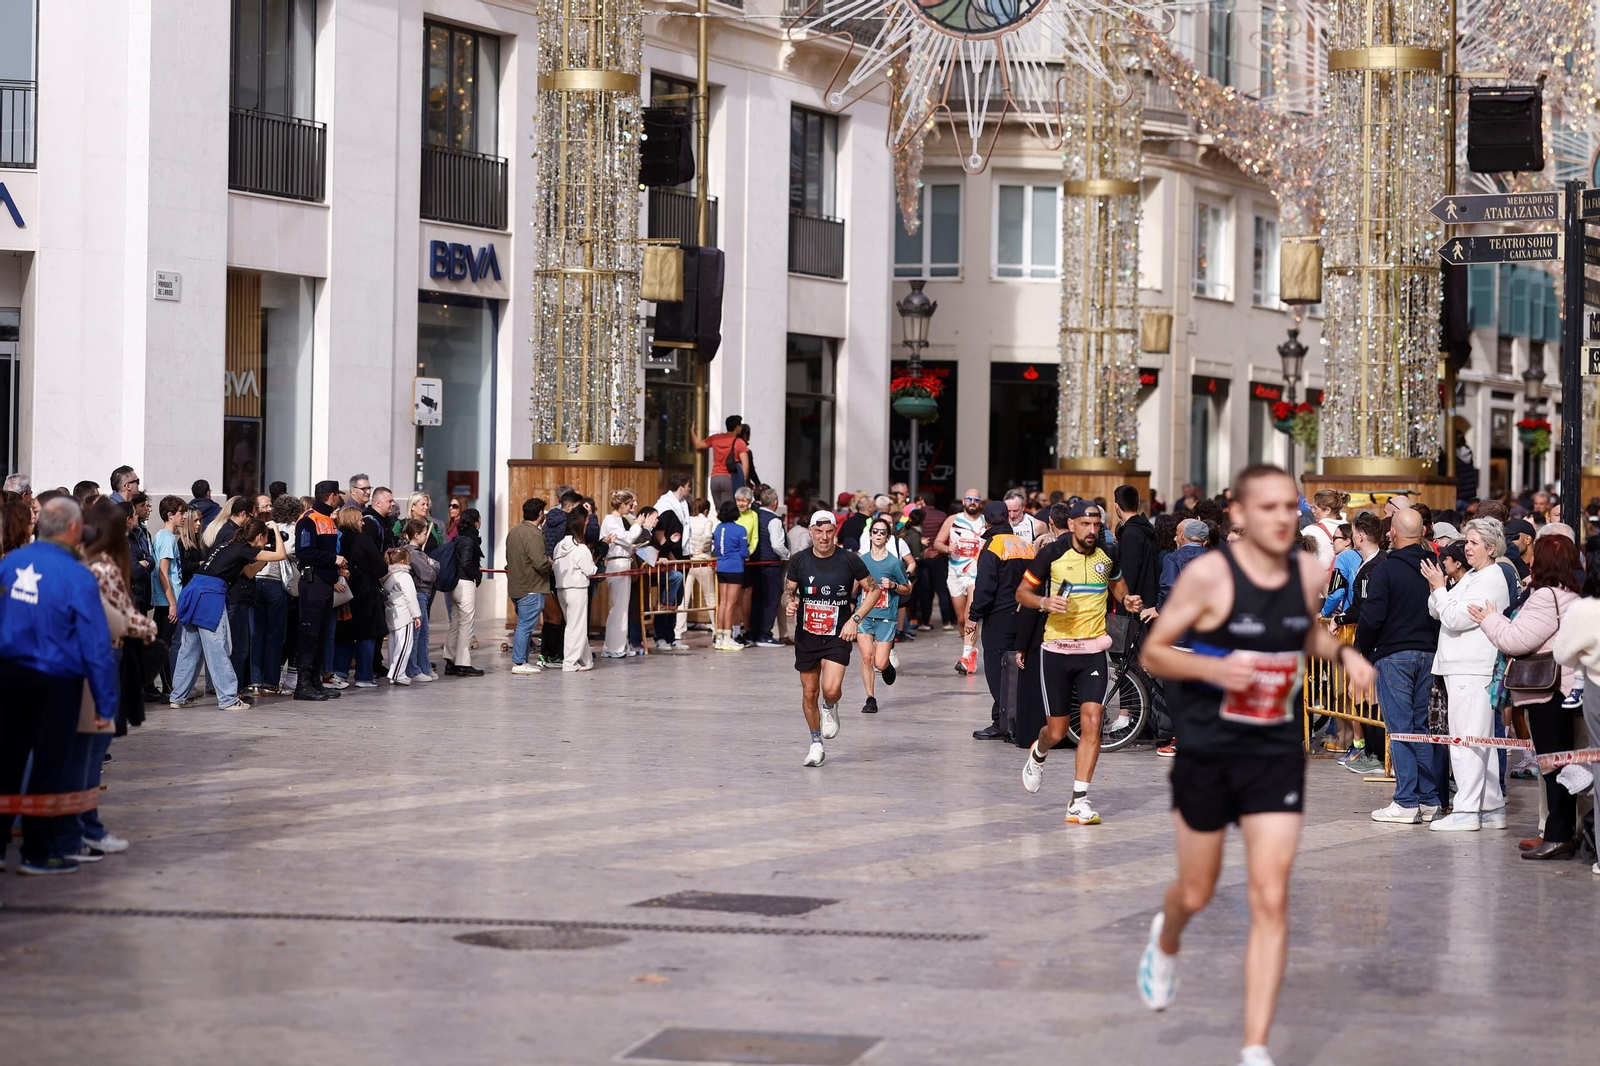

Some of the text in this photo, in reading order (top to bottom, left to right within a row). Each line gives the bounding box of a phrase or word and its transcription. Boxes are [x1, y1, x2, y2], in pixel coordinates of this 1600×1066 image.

[1507, 195, 1554, 205] MERCADO DE
[1483, 204, 1554, 219] ATARAZANAS
[1489, 236, 1553, 249] TEATRO SOHO
[1509, 248, 1553, 259] CAIXA BANK
[430, 240, 501, 282] BBVA
[892, 440, 934, 454] Wrk
[892, 454, 927, 471] Caé
